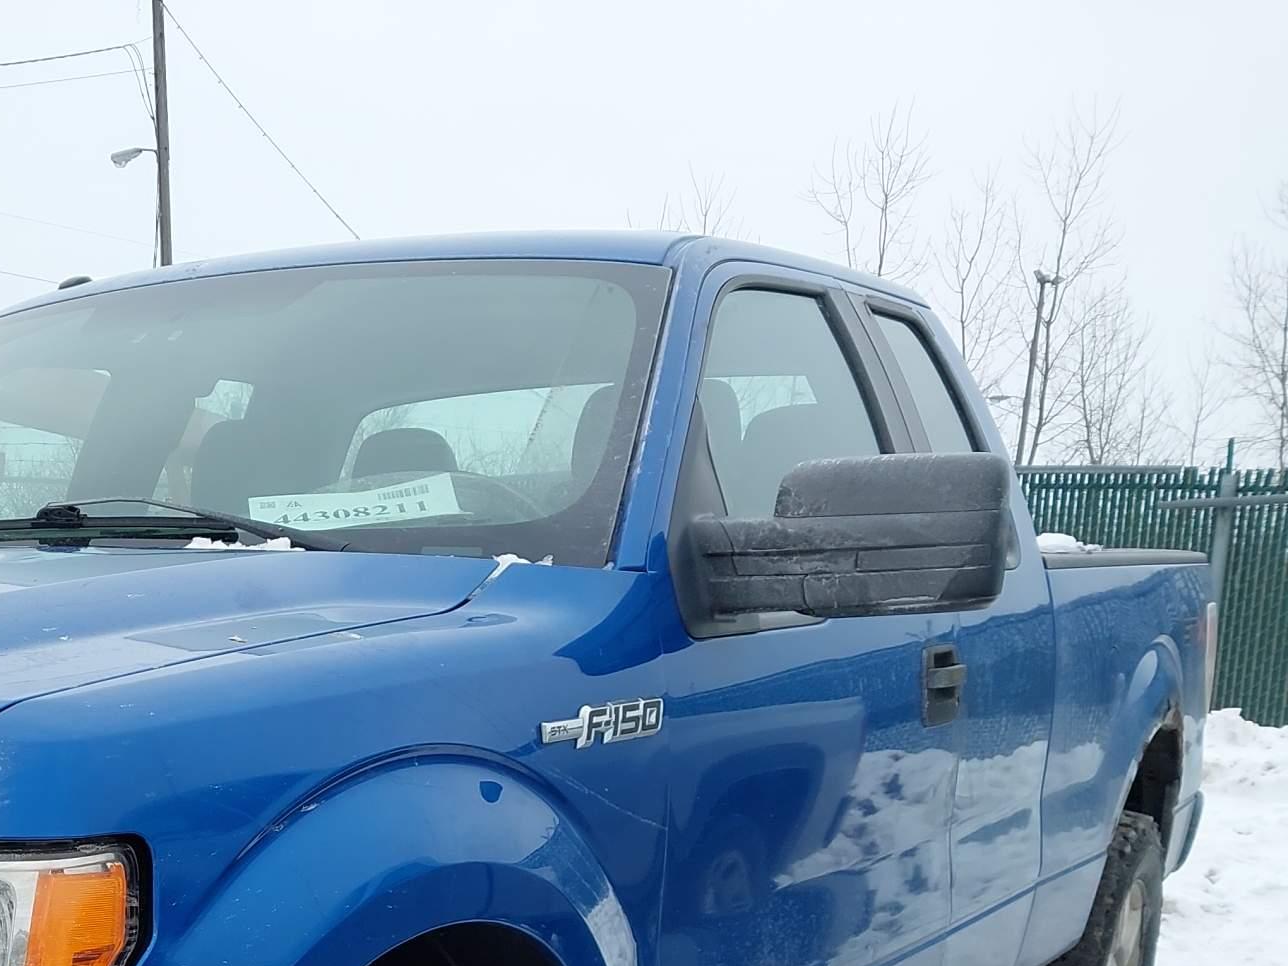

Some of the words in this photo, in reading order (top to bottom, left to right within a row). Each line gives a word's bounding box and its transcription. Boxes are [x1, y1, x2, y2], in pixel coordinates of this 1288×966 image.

[273, 500, 428, 525] 44308211
[549, 724, 569, 737] STX
[584, 699, 663, 745] F-150
